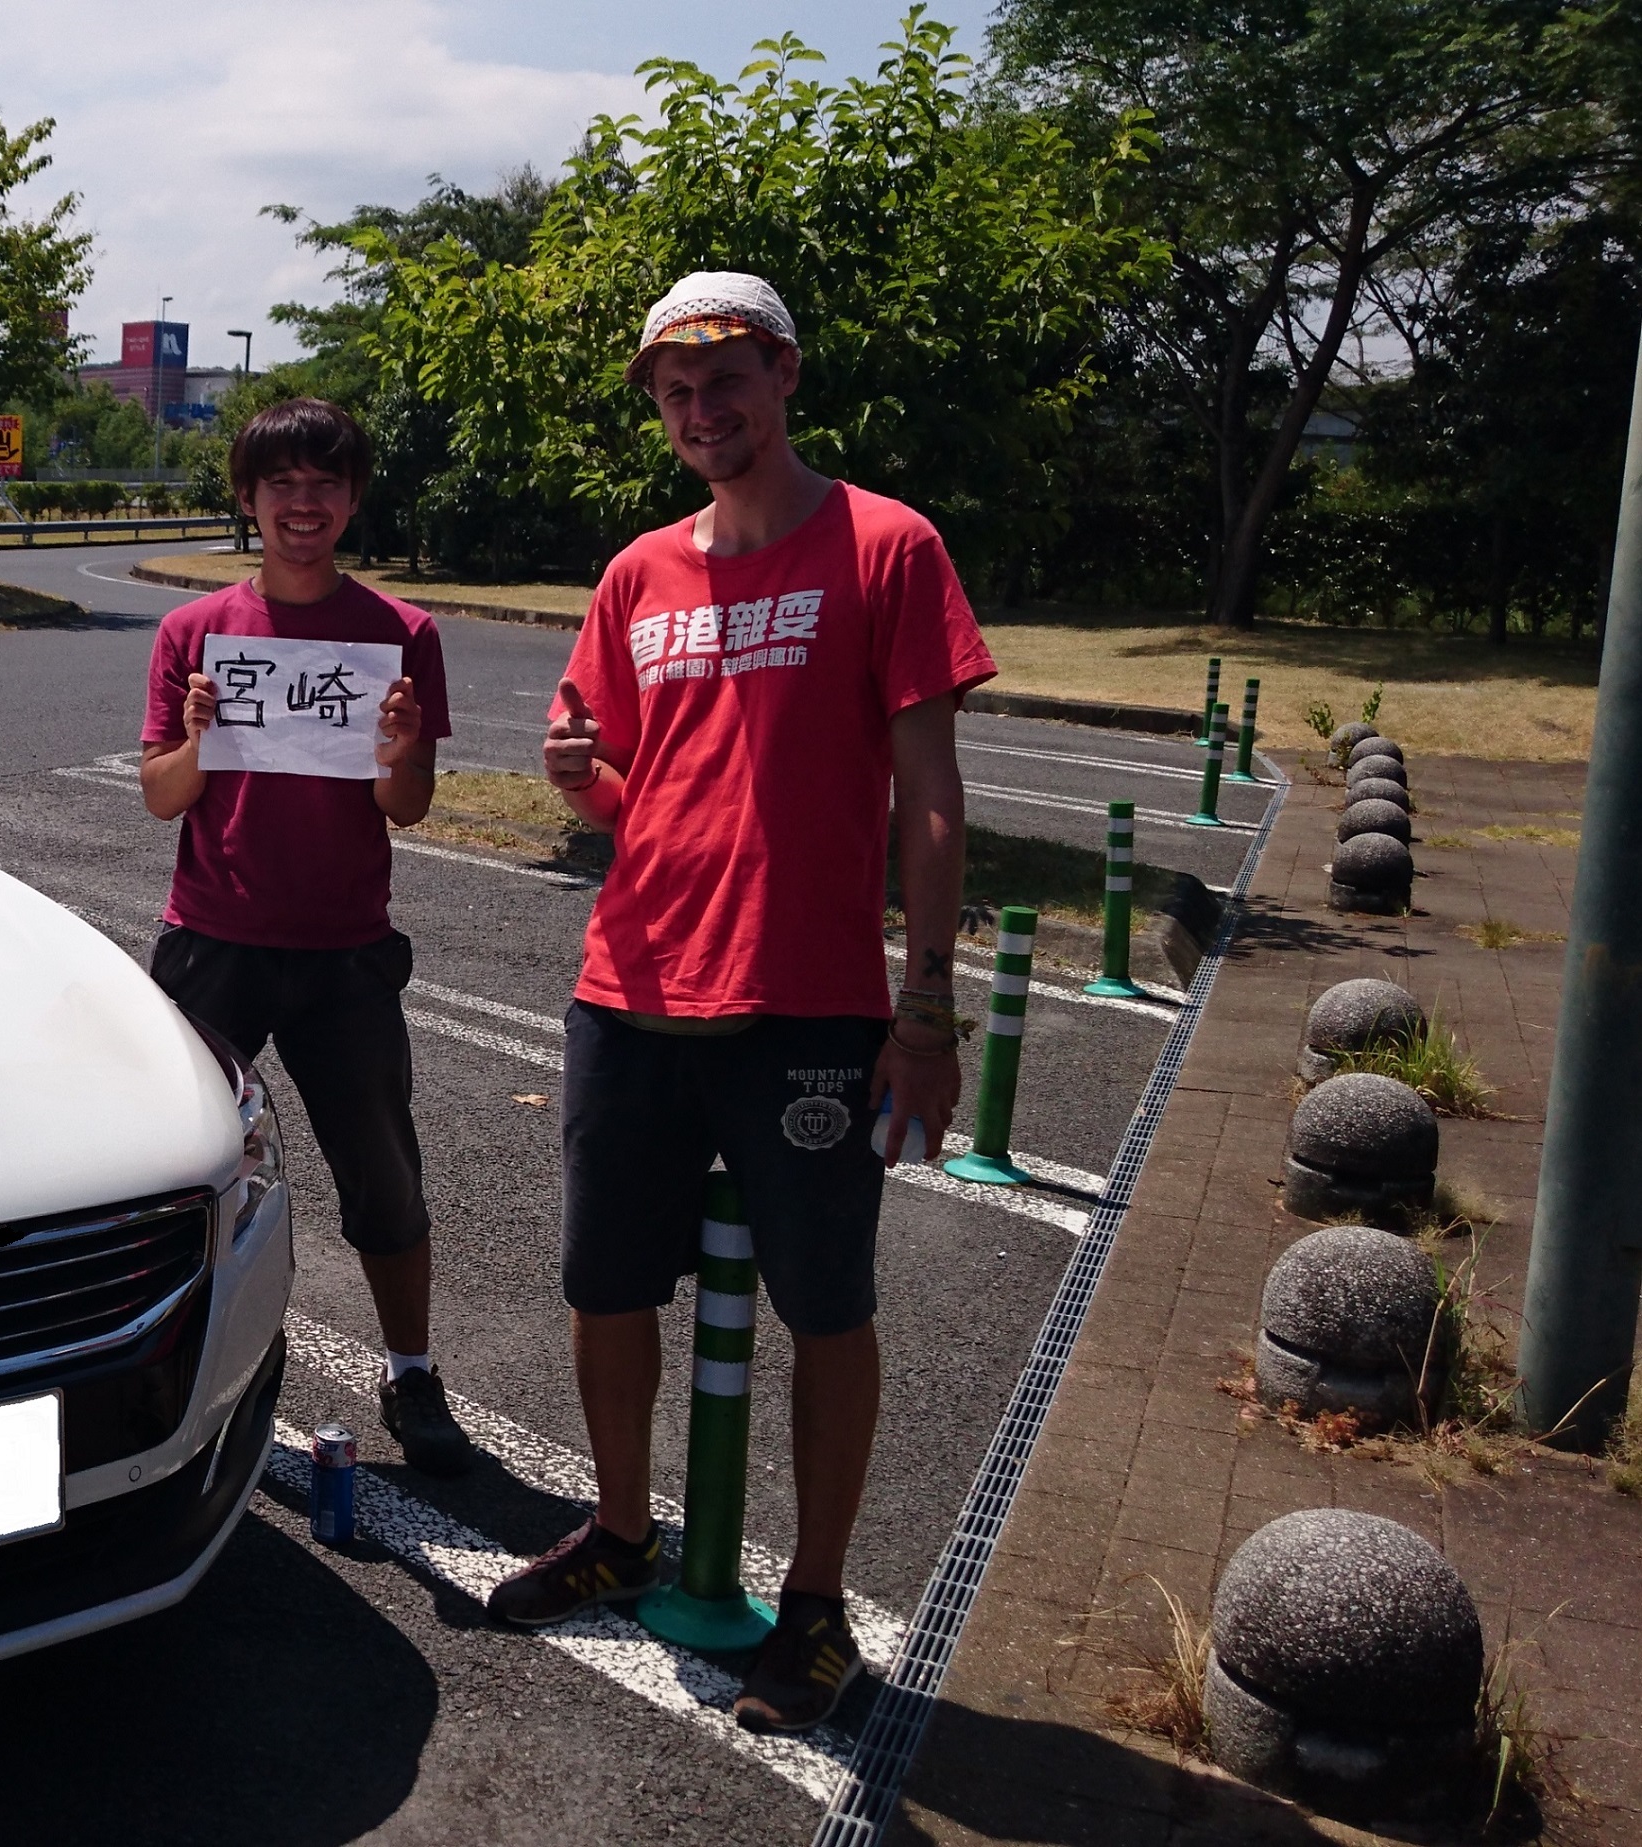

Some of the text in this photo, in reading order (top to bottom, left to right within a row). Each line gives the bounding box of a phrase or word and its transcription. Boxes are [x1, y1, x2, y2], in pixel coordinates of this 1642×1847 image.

[630, 589, 824, 669] 香港雜耍
[215, 652, 367, 728] 宮崎
[787, 1068, 863, 1081] MOUNTAIN
